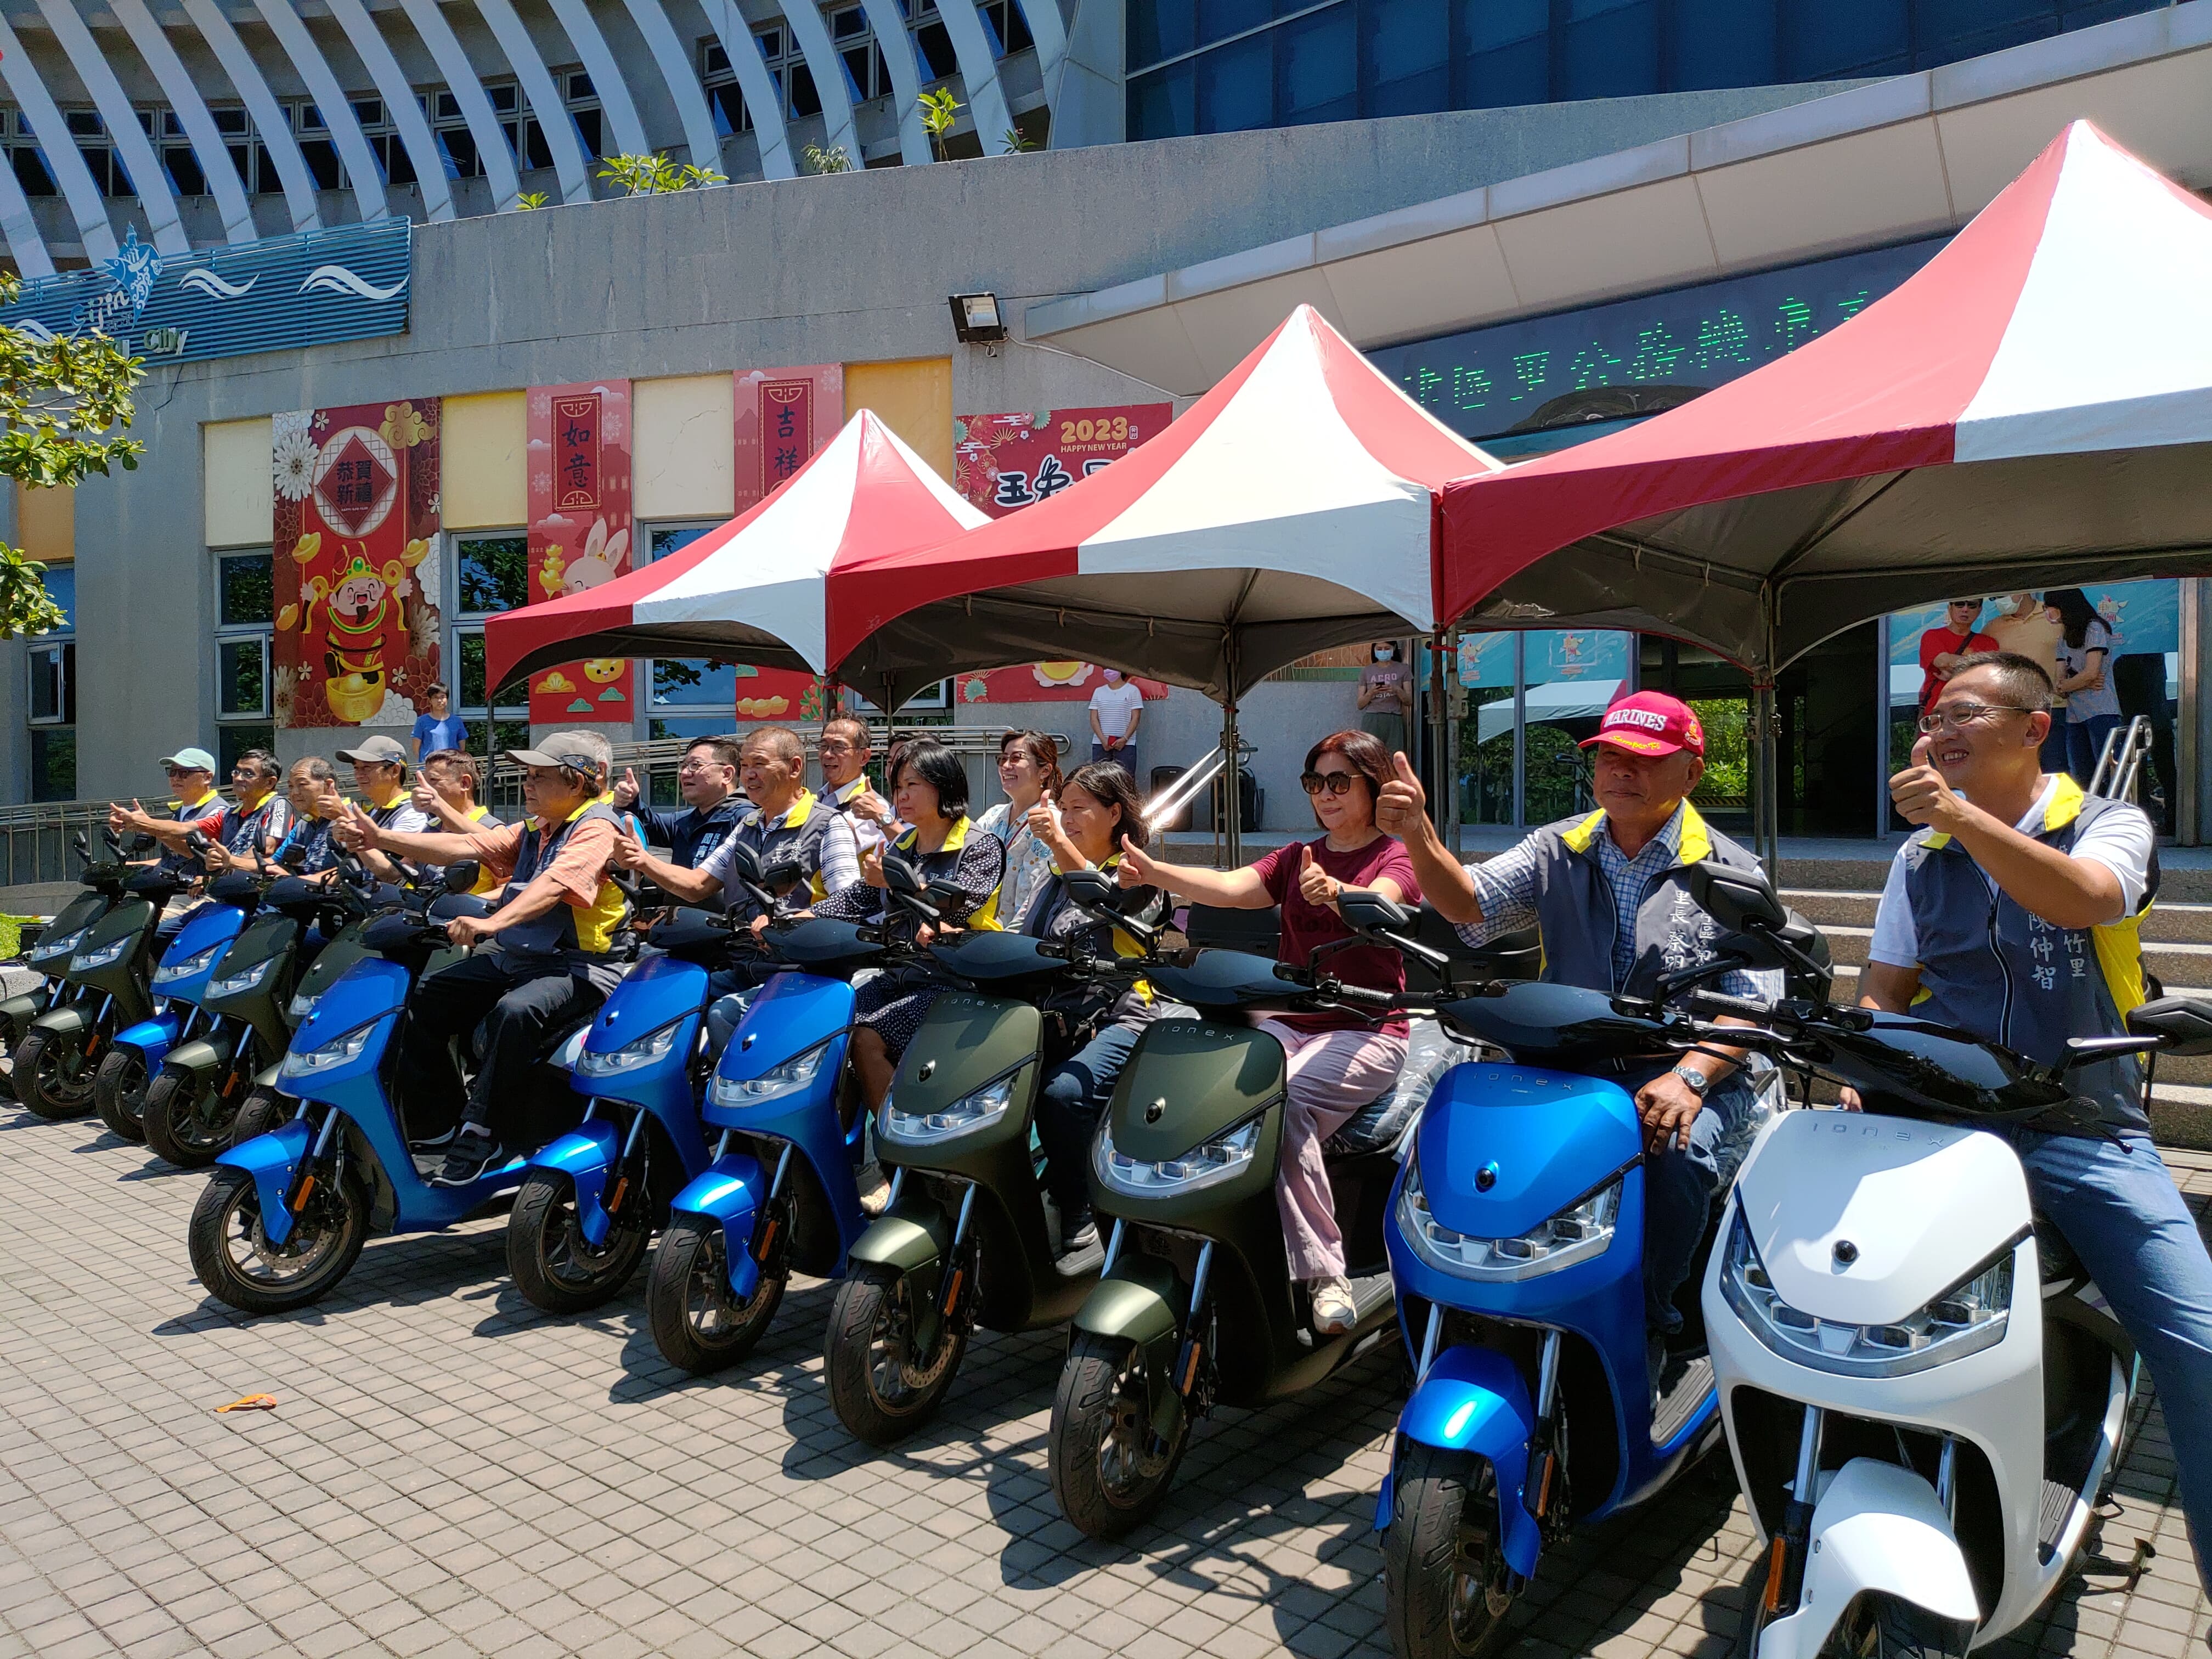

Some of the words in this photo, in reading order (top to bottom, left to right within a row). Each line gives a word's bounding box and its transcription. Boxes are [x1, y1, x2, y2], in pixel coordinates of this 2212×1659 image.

[1060, 416, 1128, 444] 2023
[774, 405, 799, 477] 吉祥
[1060, 443, 1087, 453] HAPPY
[1088, 443, 1106, 451] NEW
[1107, 442, 1127, 450] YEAR
[561, 419, 591, 487] 如意
[1371, 673, 1397, 683] AERO
[1604, 709, 1668, 732] MARINES
[943, 998, 1001, 1009] ionex
[1162, 1026, 1234, 1041] ionex
[1474, 1073, 1572, 1091] ionex
[1813, 1123, 1944, 1147] ionex
